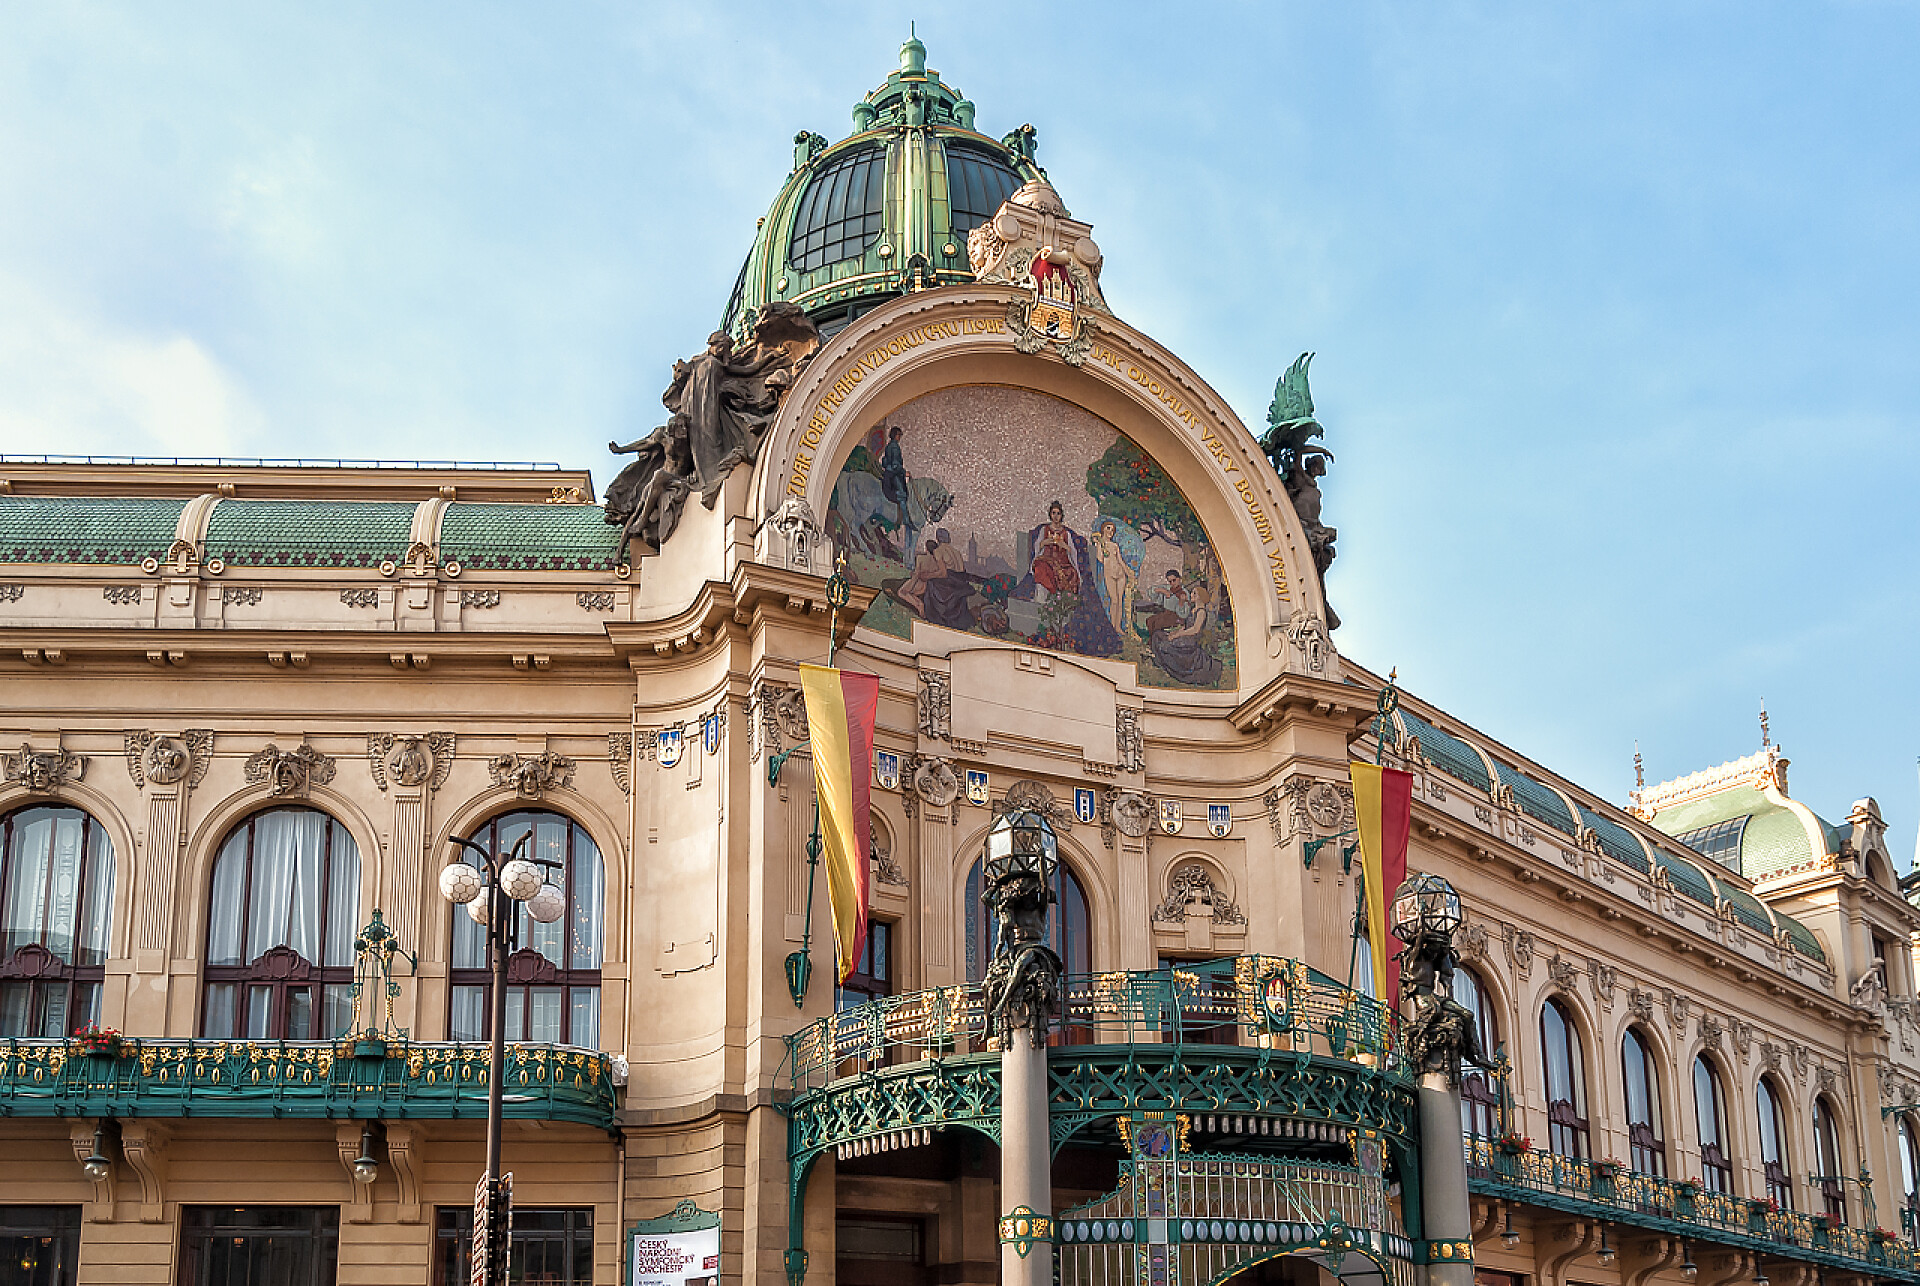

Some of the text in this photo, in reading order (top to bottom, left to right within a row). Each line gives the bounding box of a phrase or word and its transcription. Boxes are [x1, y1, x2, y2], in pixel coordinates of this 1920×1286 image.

[1090, 346, 1125, 373] JAK
[1127, 367, 1200, 429] ODOLALAS
[786, 452, 813, 496] ZDAR
[639, 1264, 684, 1275] ORCHESTR
